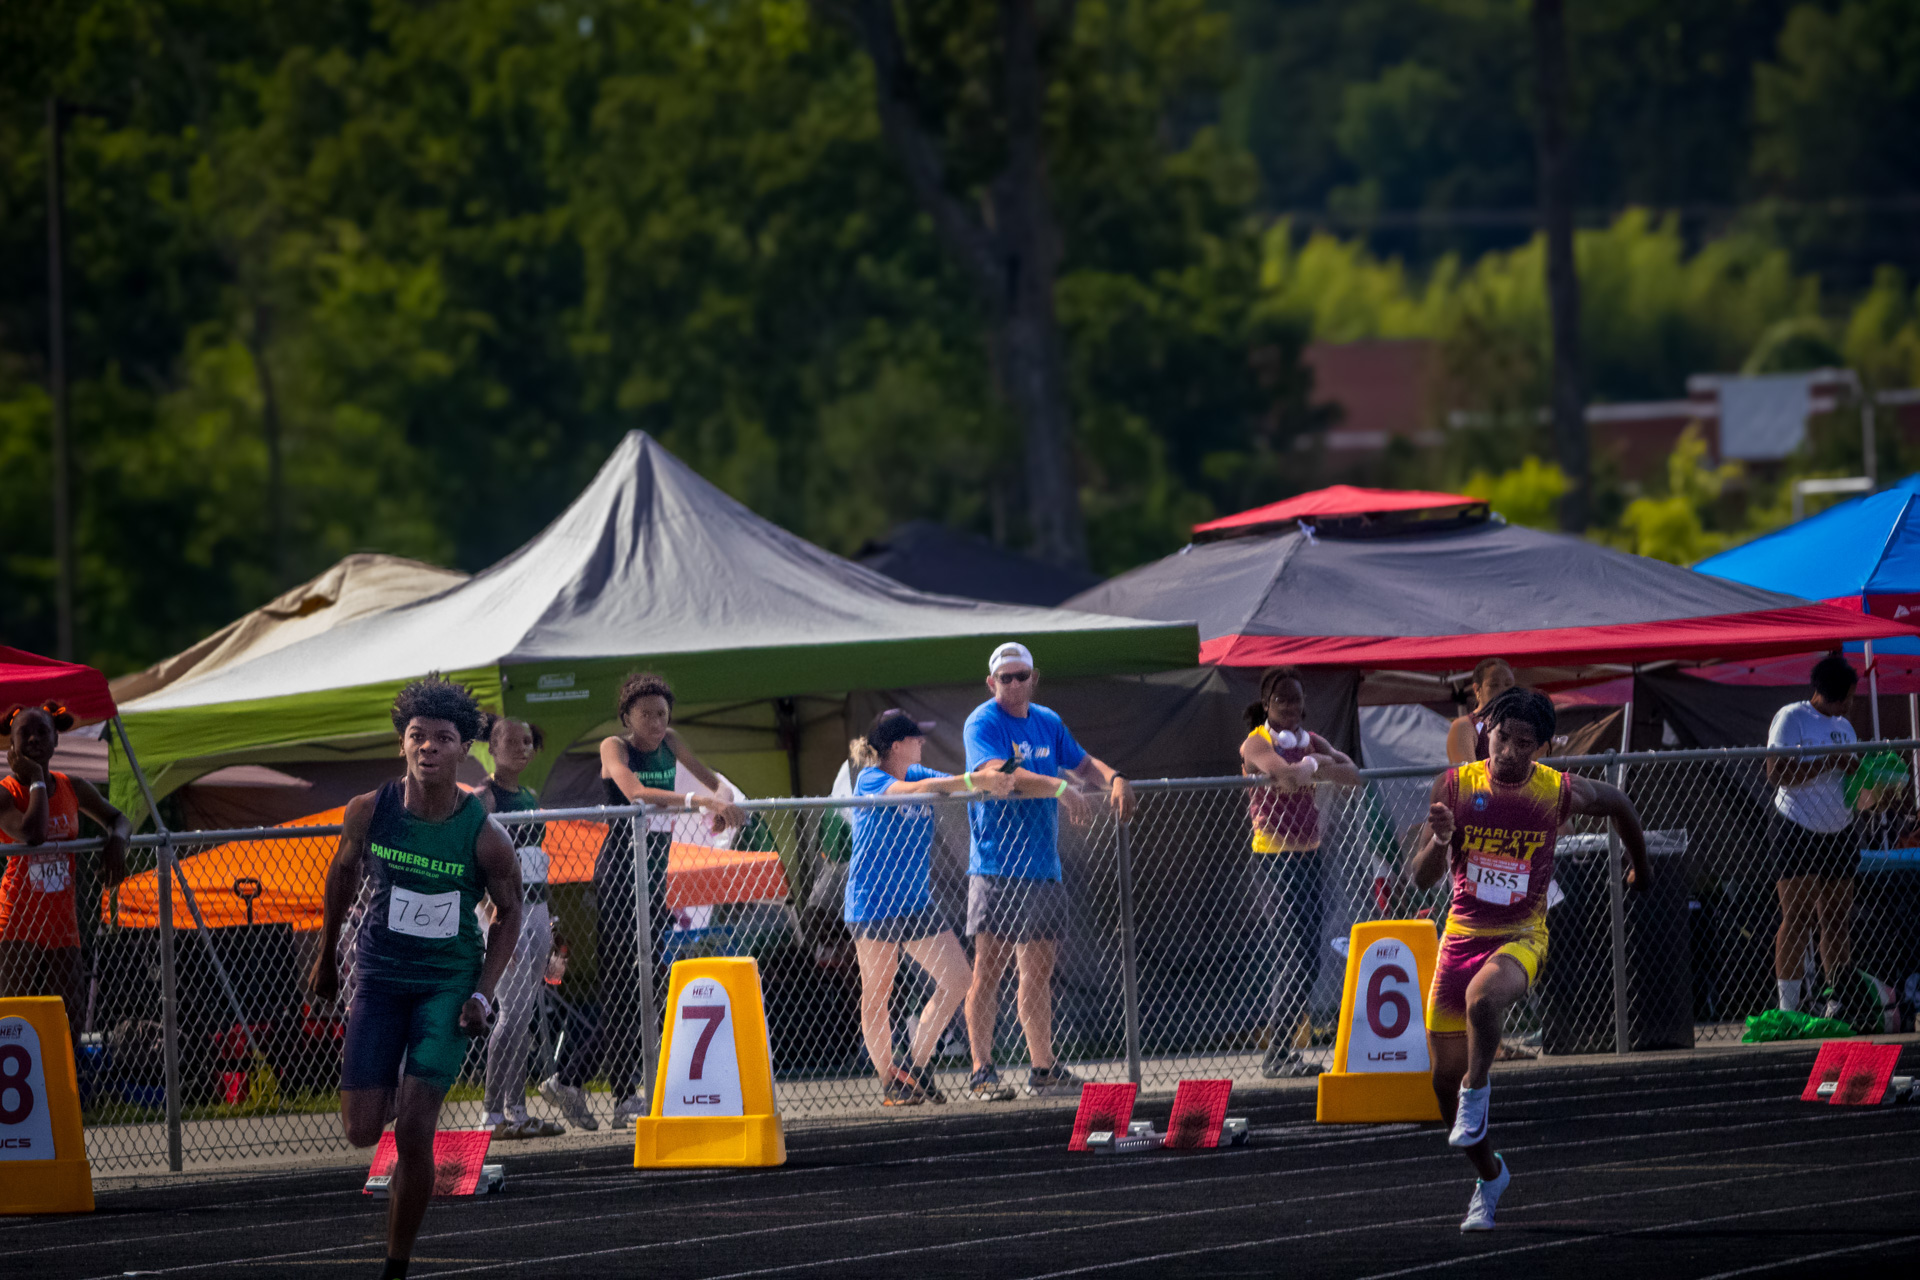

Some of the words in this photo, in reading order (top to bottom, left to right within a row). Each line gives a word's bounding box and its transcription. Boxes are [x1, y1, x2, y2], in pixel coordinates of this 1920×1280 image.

[1464, 825, 1548, 842] CHARLOTTE
[371, 842, 429, 868] PANTHERS
[431, 859, 465, 877] ELITE
[388, 863, 405, 871] TRACK
[1476, 868, 1519, 889] 1855
[396, 898, 452, 927] 767
[1366, 964, 1411, 1039] 6
[682, 1005, 725, 1080] 7
[1367, 1051, 1408, 1061] UCS
[0, 1044, 34, 1125] 8
[683, 1095, 721, 1104] UCS
